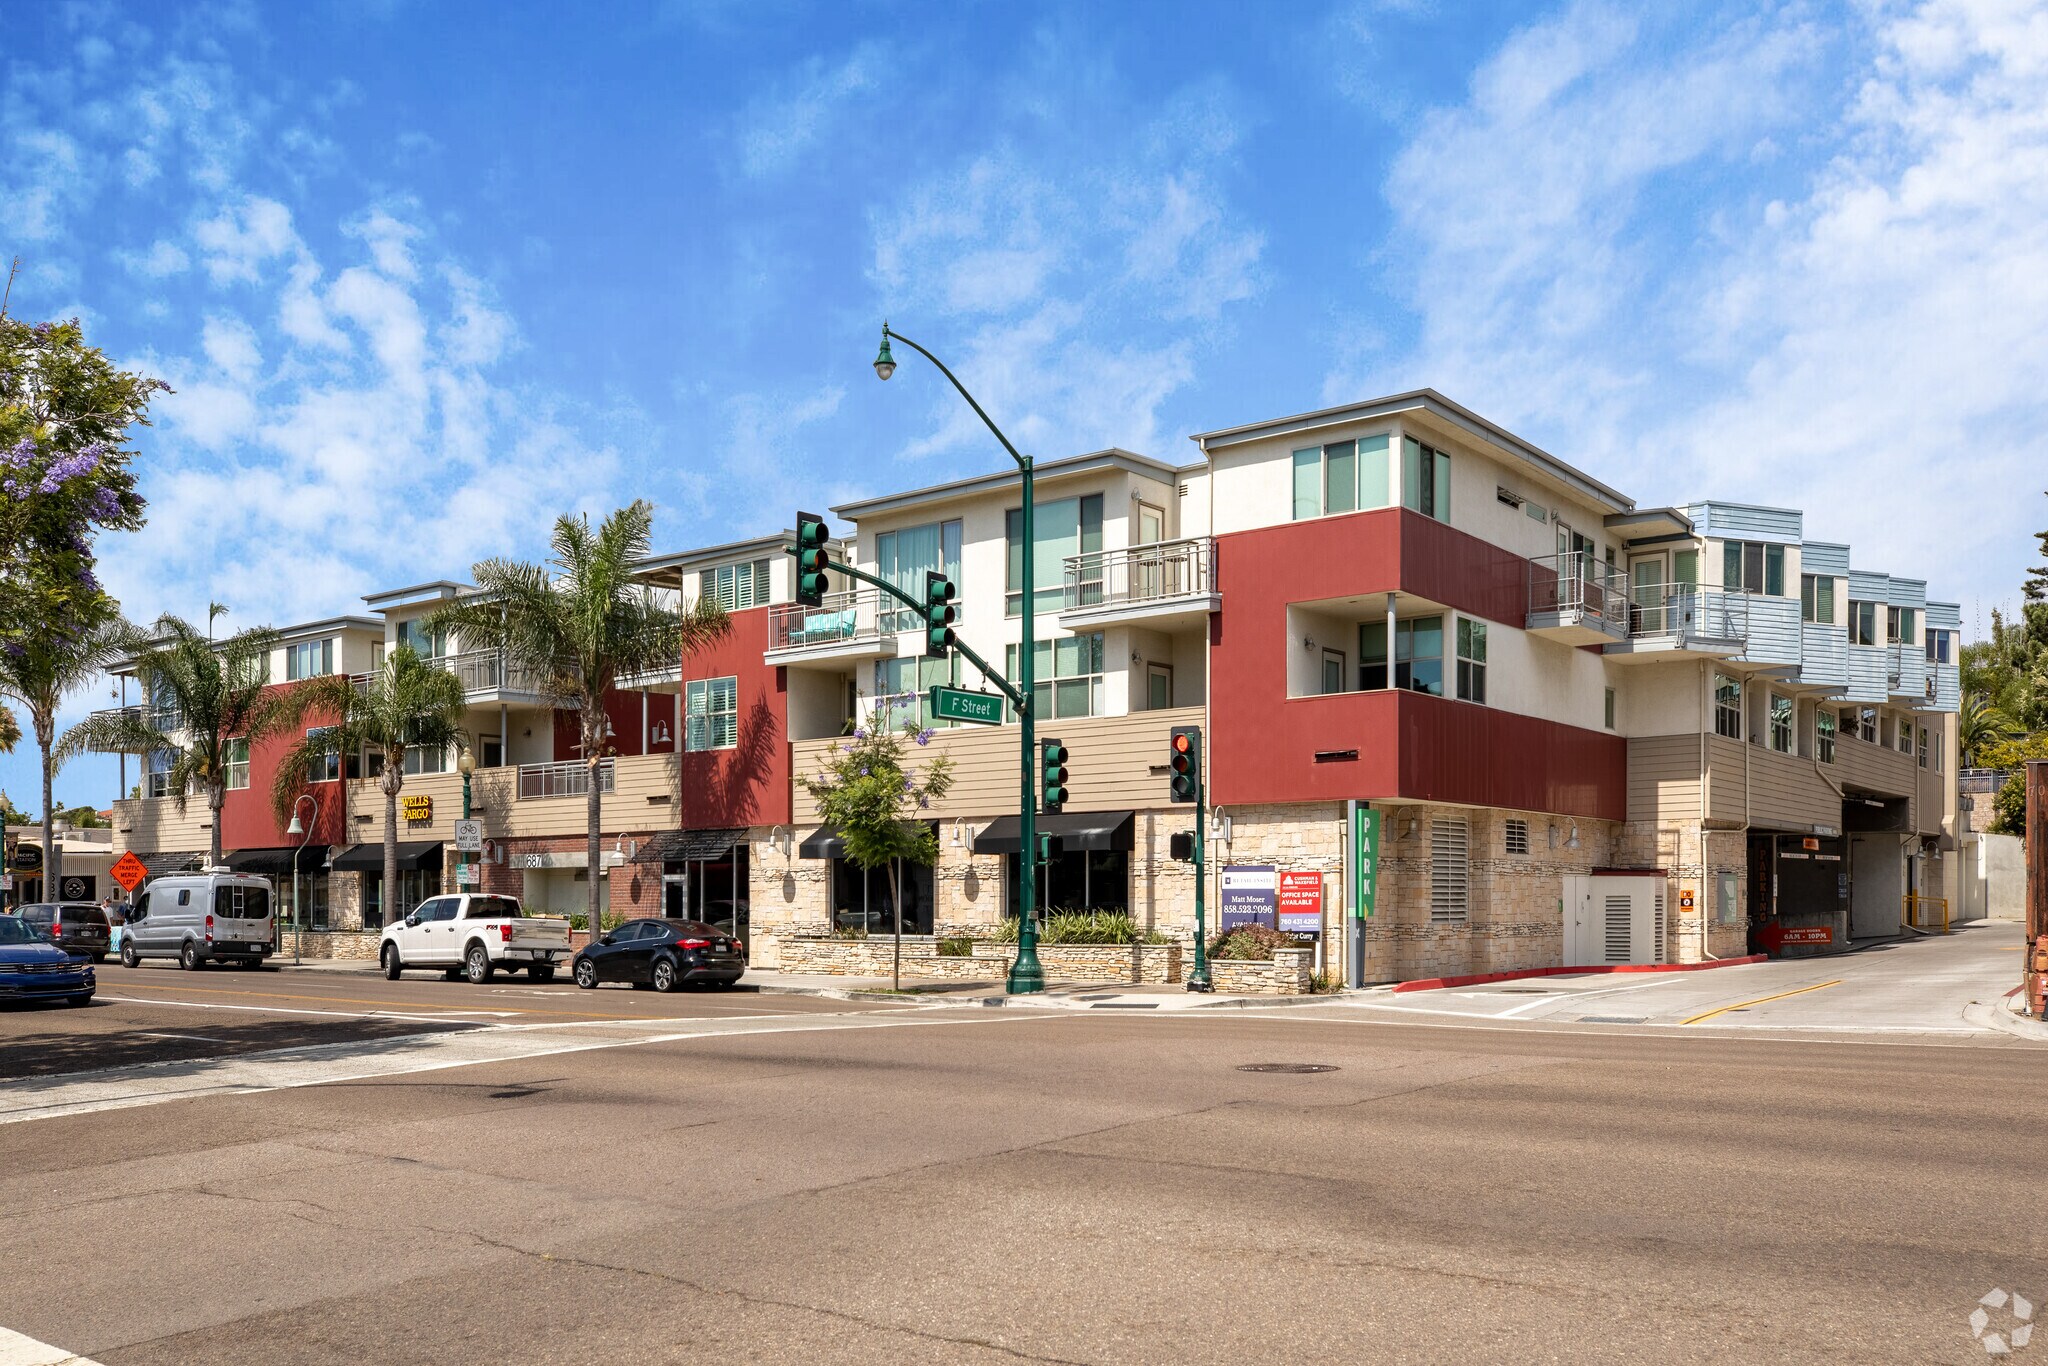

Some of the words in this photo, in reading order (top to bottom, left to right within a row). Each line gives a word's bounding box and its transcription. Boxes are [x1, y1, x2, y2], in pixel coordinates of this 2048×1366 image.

[952, 697, 959, 711] F
[961, 699, 991, 716] Street
[401, 795, 429, 807] WELLS
[402, 808, 429, 820] FARGO
[527, 854, 542, 868] 687
[1363, 817, 1371, 895] PARK
[1759, 849, 1767, 922] PARKING
[1231, 895, 1246, 903] Matt
[1246, 895, 1266, 903] Moser
[1223, 904, 1273, 914] 858.523.2096
[1299, 932, 1314, 941] Curry
